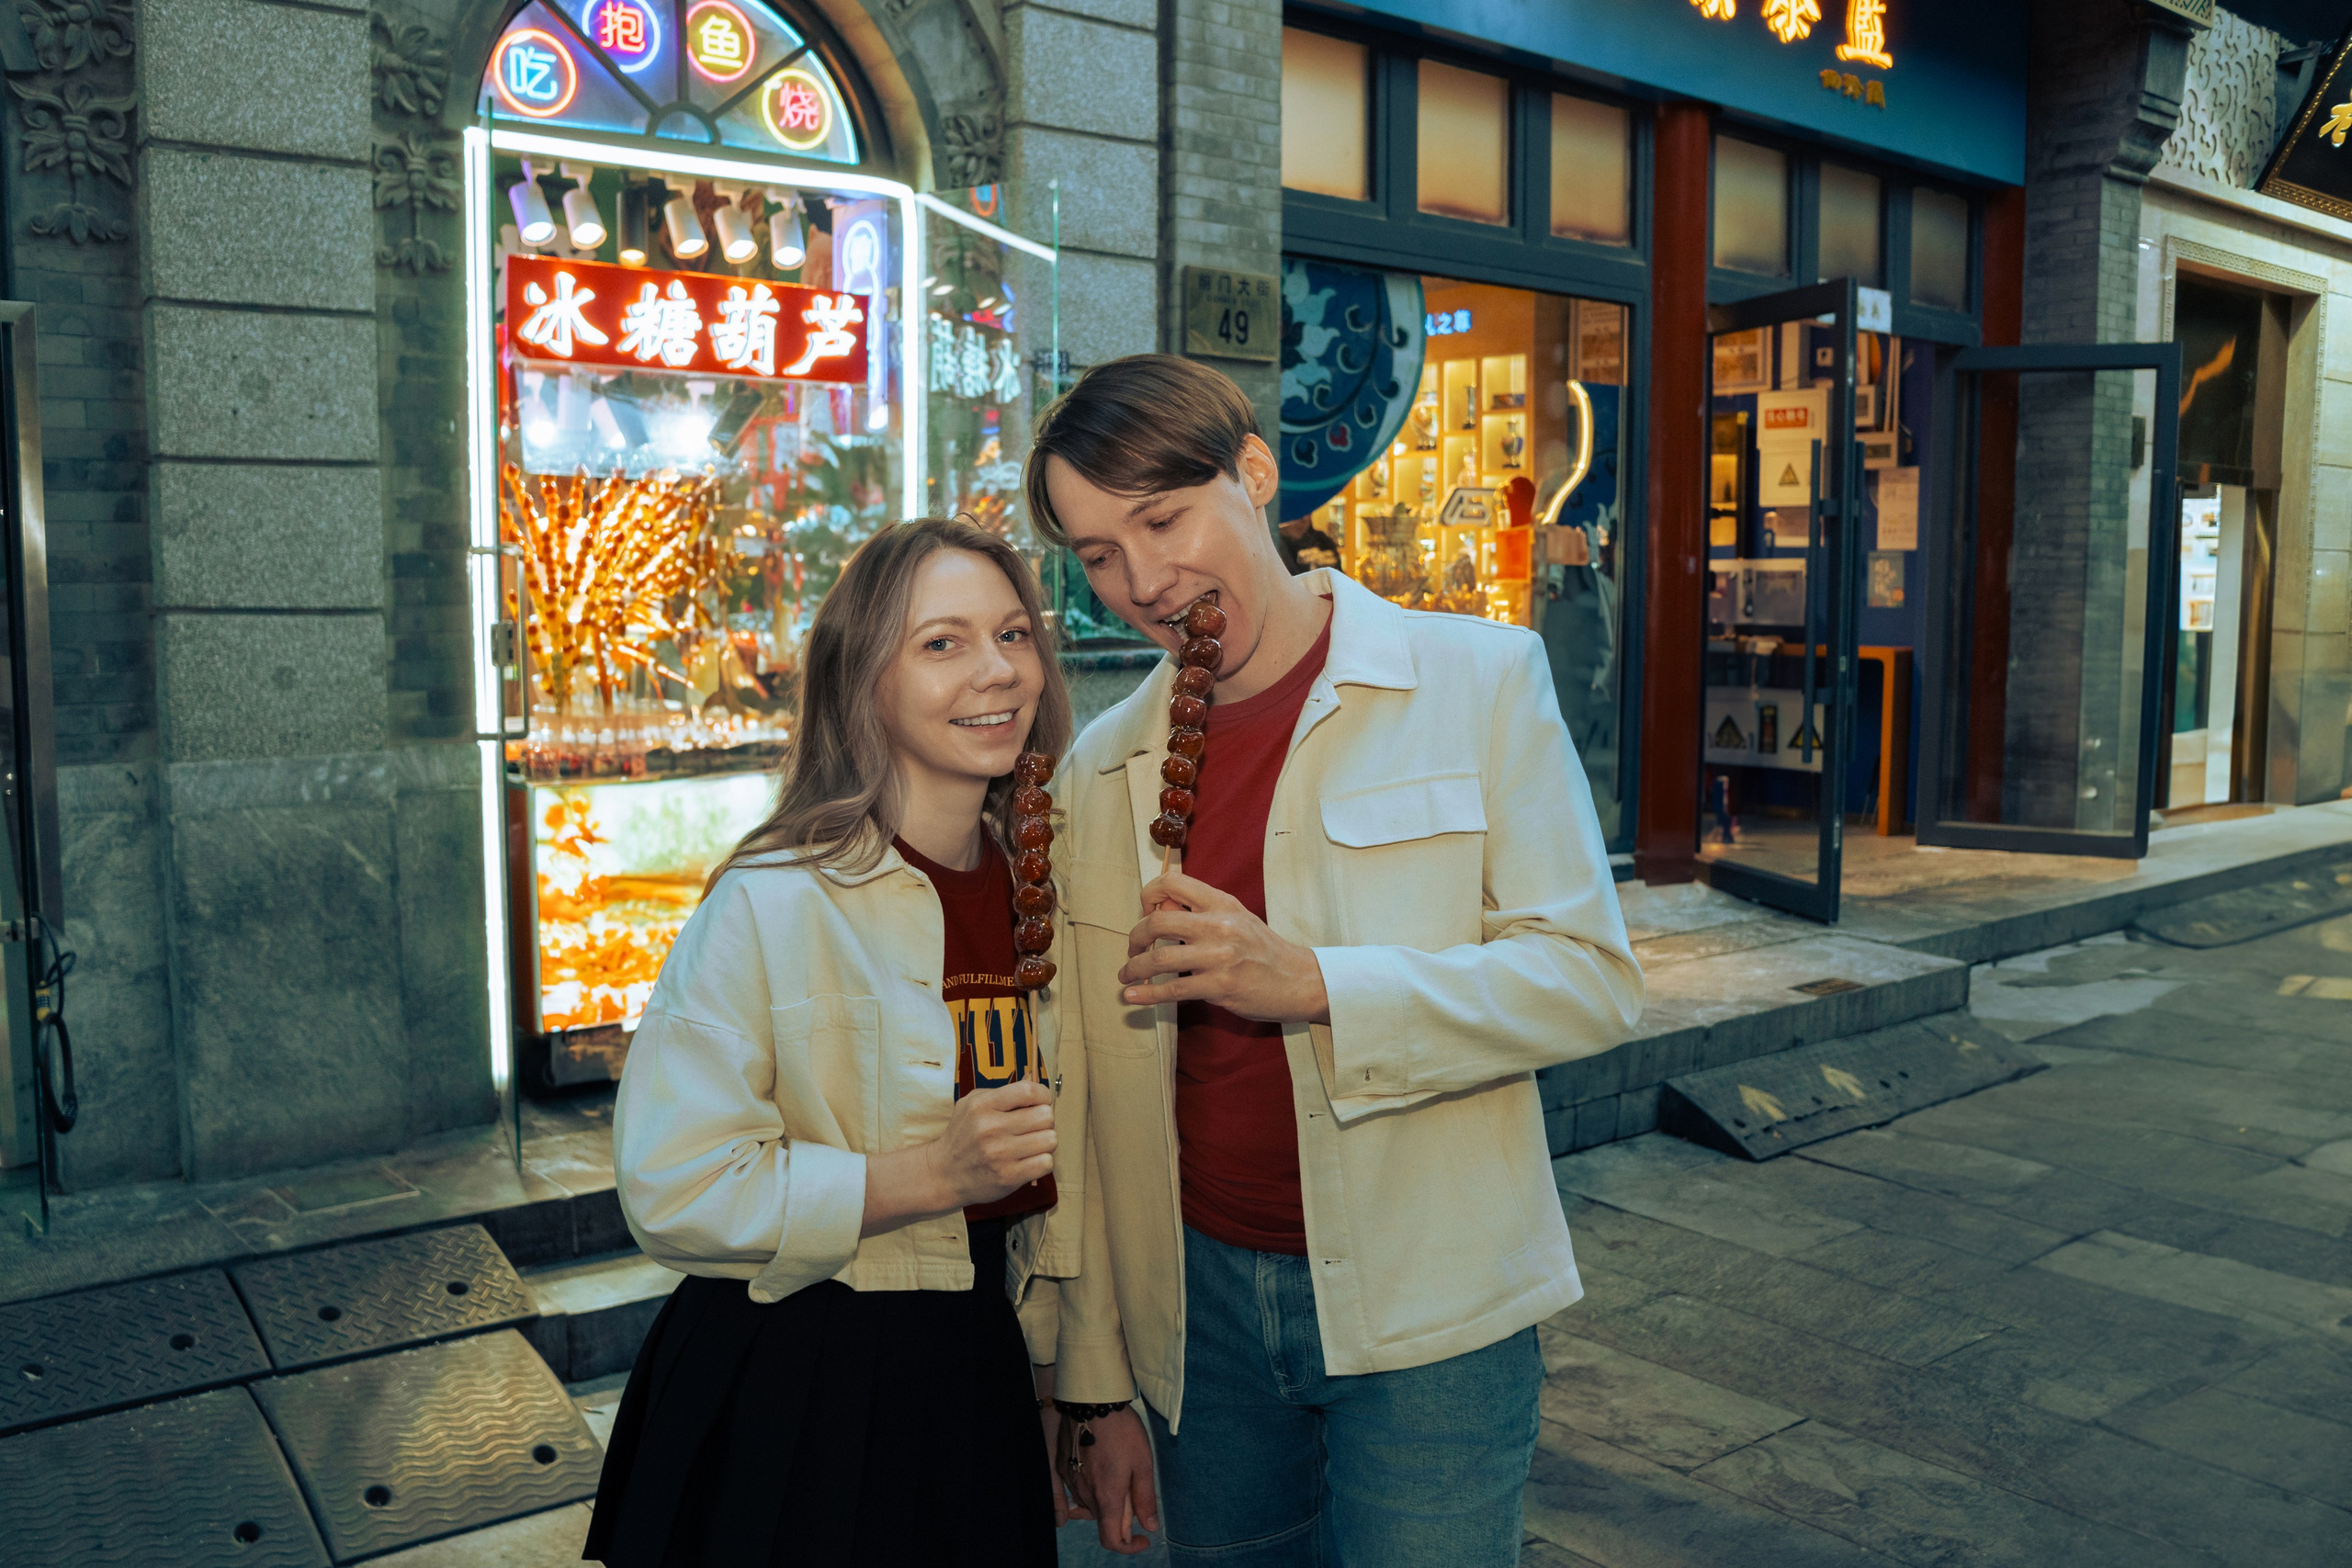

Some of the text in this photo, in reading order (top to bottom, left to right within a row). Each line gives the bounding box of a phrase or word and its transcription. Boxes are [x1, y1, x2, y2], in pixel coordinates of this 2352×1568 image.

[519, 270, 865, 377] 冰糖葫芦
[1218, 308, 1250, 345] 49
[959, 973, 1016, 987] FULFILLME
